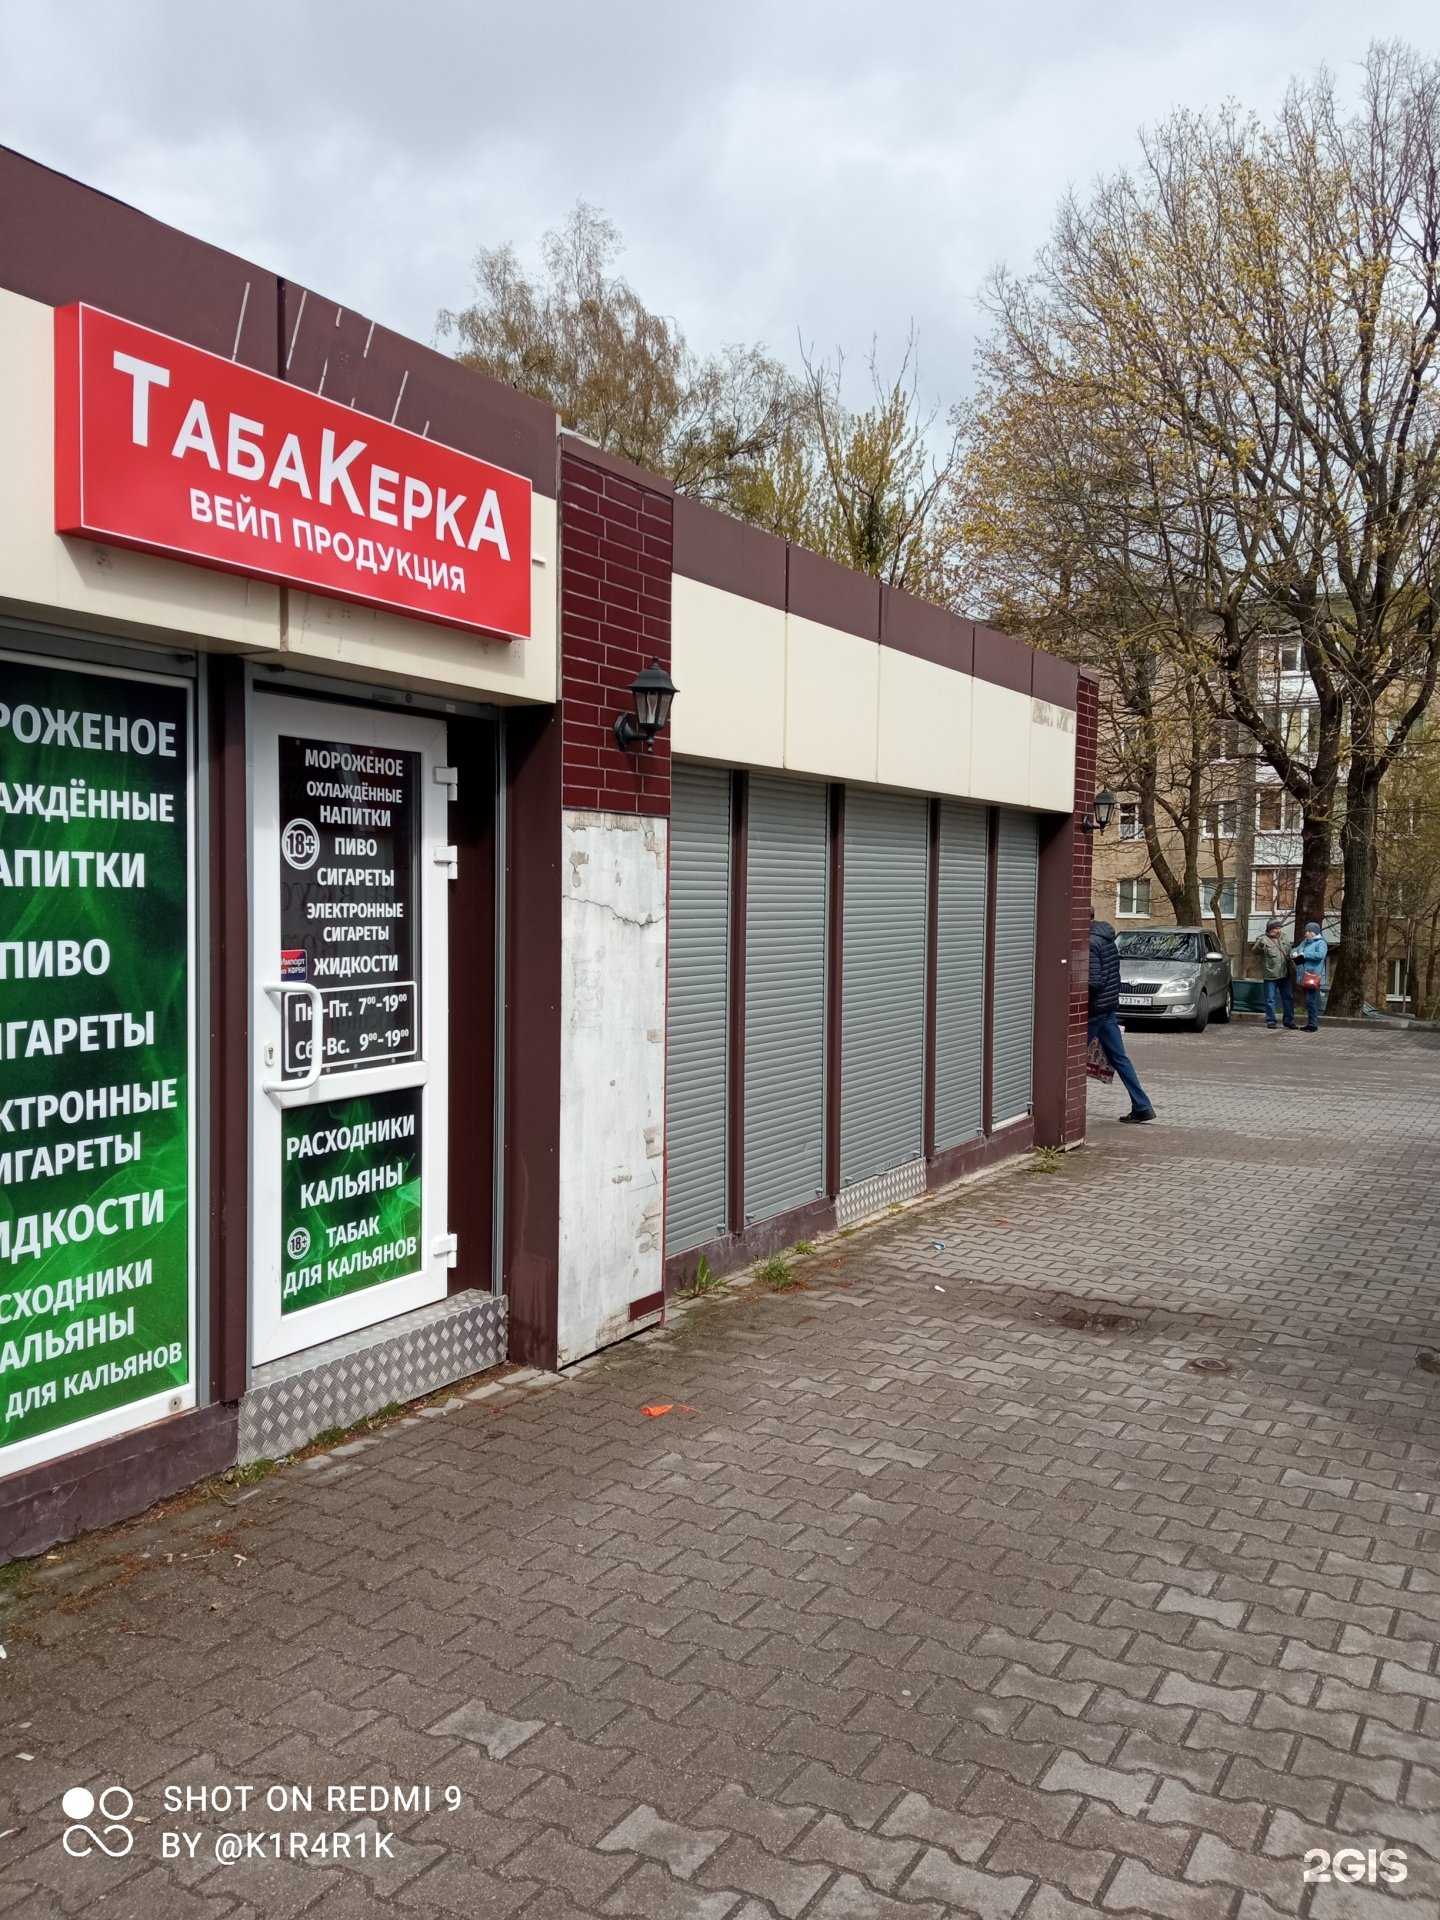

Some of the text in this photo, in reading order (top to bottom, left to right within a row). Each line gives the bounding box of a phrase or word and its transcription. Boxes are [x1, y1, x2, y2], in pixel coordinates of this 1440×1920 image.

[189, 488, 466, 593] ВЕЙП ПРОДУКЦИЯ
[305, 748, 404, 777] МОРОЖЕНОЕ
[306, 781, 403, 803] ОХЛАЖДЁННЫЕ
[320, 805, 391, 827] НАПИТКИ
[287, 830, 316, 858] 18+
[335, 837, 378, 857] ПИВО
[316, 867, 395, 887] СИГАРЕТЫ
[306, 902, 404, 920] ЭЛЕКТРОННЫЕ
[323, 925, 390, 943] СИГАРЕТЫ
[0, 938, 110, 980] ПИВО
[313, 954, 399, 978] ЖИДКОСТИ
[0, 1010, 154, 1060] ГАРЕТЫ
[286, 1114, 415, 1161] РАСХОДНИКИ
[300, 1162, 404, 1209] КАЛЬЯНЫ
[326, 1216, 380, 1249] ТАБАК
[283, 1236, 417, 1299] ДЛЯ КАЛЬЯНОВ
[0, 1306, 135, 1374] АЛЬЯНЫ
[5, 1342, 183, 1424] ДЛЯ КАЛЬЯНОВ
